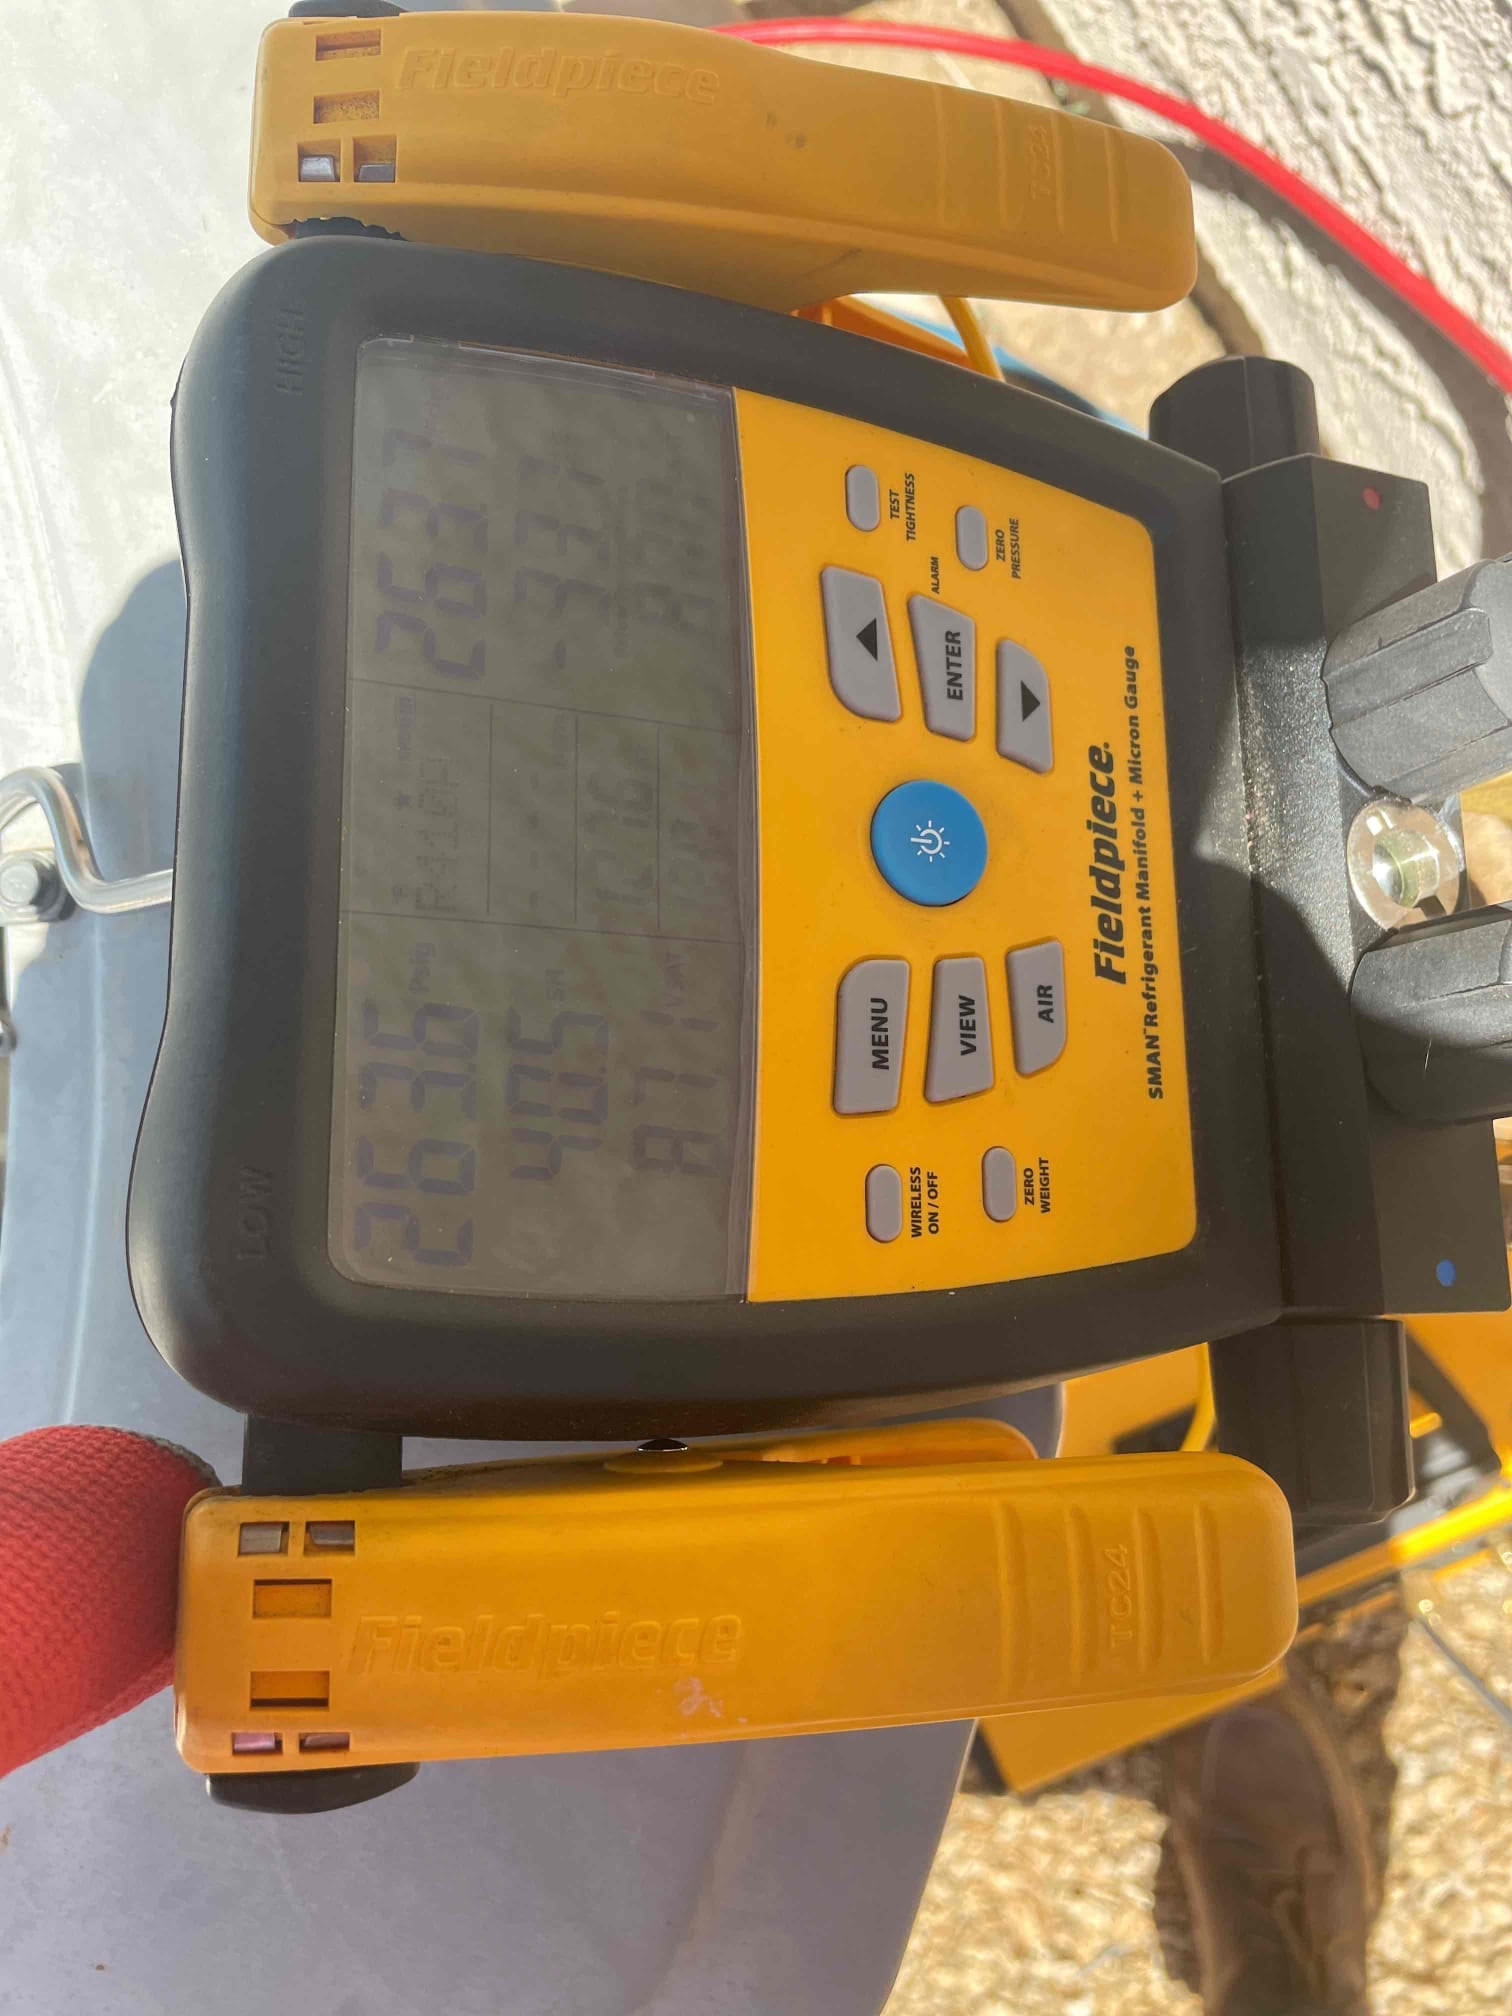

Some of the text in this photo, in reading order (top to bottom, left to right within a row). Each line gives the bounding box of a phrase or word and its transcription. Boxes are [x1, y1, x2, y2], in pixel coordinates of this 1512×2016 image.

[394, 45, 720, 104] Fieldpiece
[273, 306, 304, 397] HIGH
[888, 488, 900, 521] TEST
[904, 472, 917, 542] TIGHTNESS
[930, 556, 940, 595] ALARM
[994, 528, 1006, 562] ZERO
[1008, 517, 1022, 580] PRESSURE
[944, 629, 964, 702] ENTER
[1123, 645, 1140, 710] Gauge
[1127, 714, 1144, 785] Micron
[1132, 789, 1144, 803] +
[1129, 807, 1150, 900] Manifold
[1138, 905, 1160, 1028] Refrigerant
[870, 997, 890, 1071] MENU
[958, 994, 977, 1056] VIEW
[1036, 984, 1054, 1024] AIR
[236, 1165, 275, 1261] LOW
[909, 1166, 922, 1238] WIRELESS
[926, 1171, 939, 1200] OFF
[1023, 1167, 1035, 1206] ZERO
[1038, 1157, 1051, 1214] WEIGHT
[927, 1211, 940, 1235] ON
[1104, 1542, 1134, 1650] TC24
[348, 1610, 743, 1678] Fieldpiece
